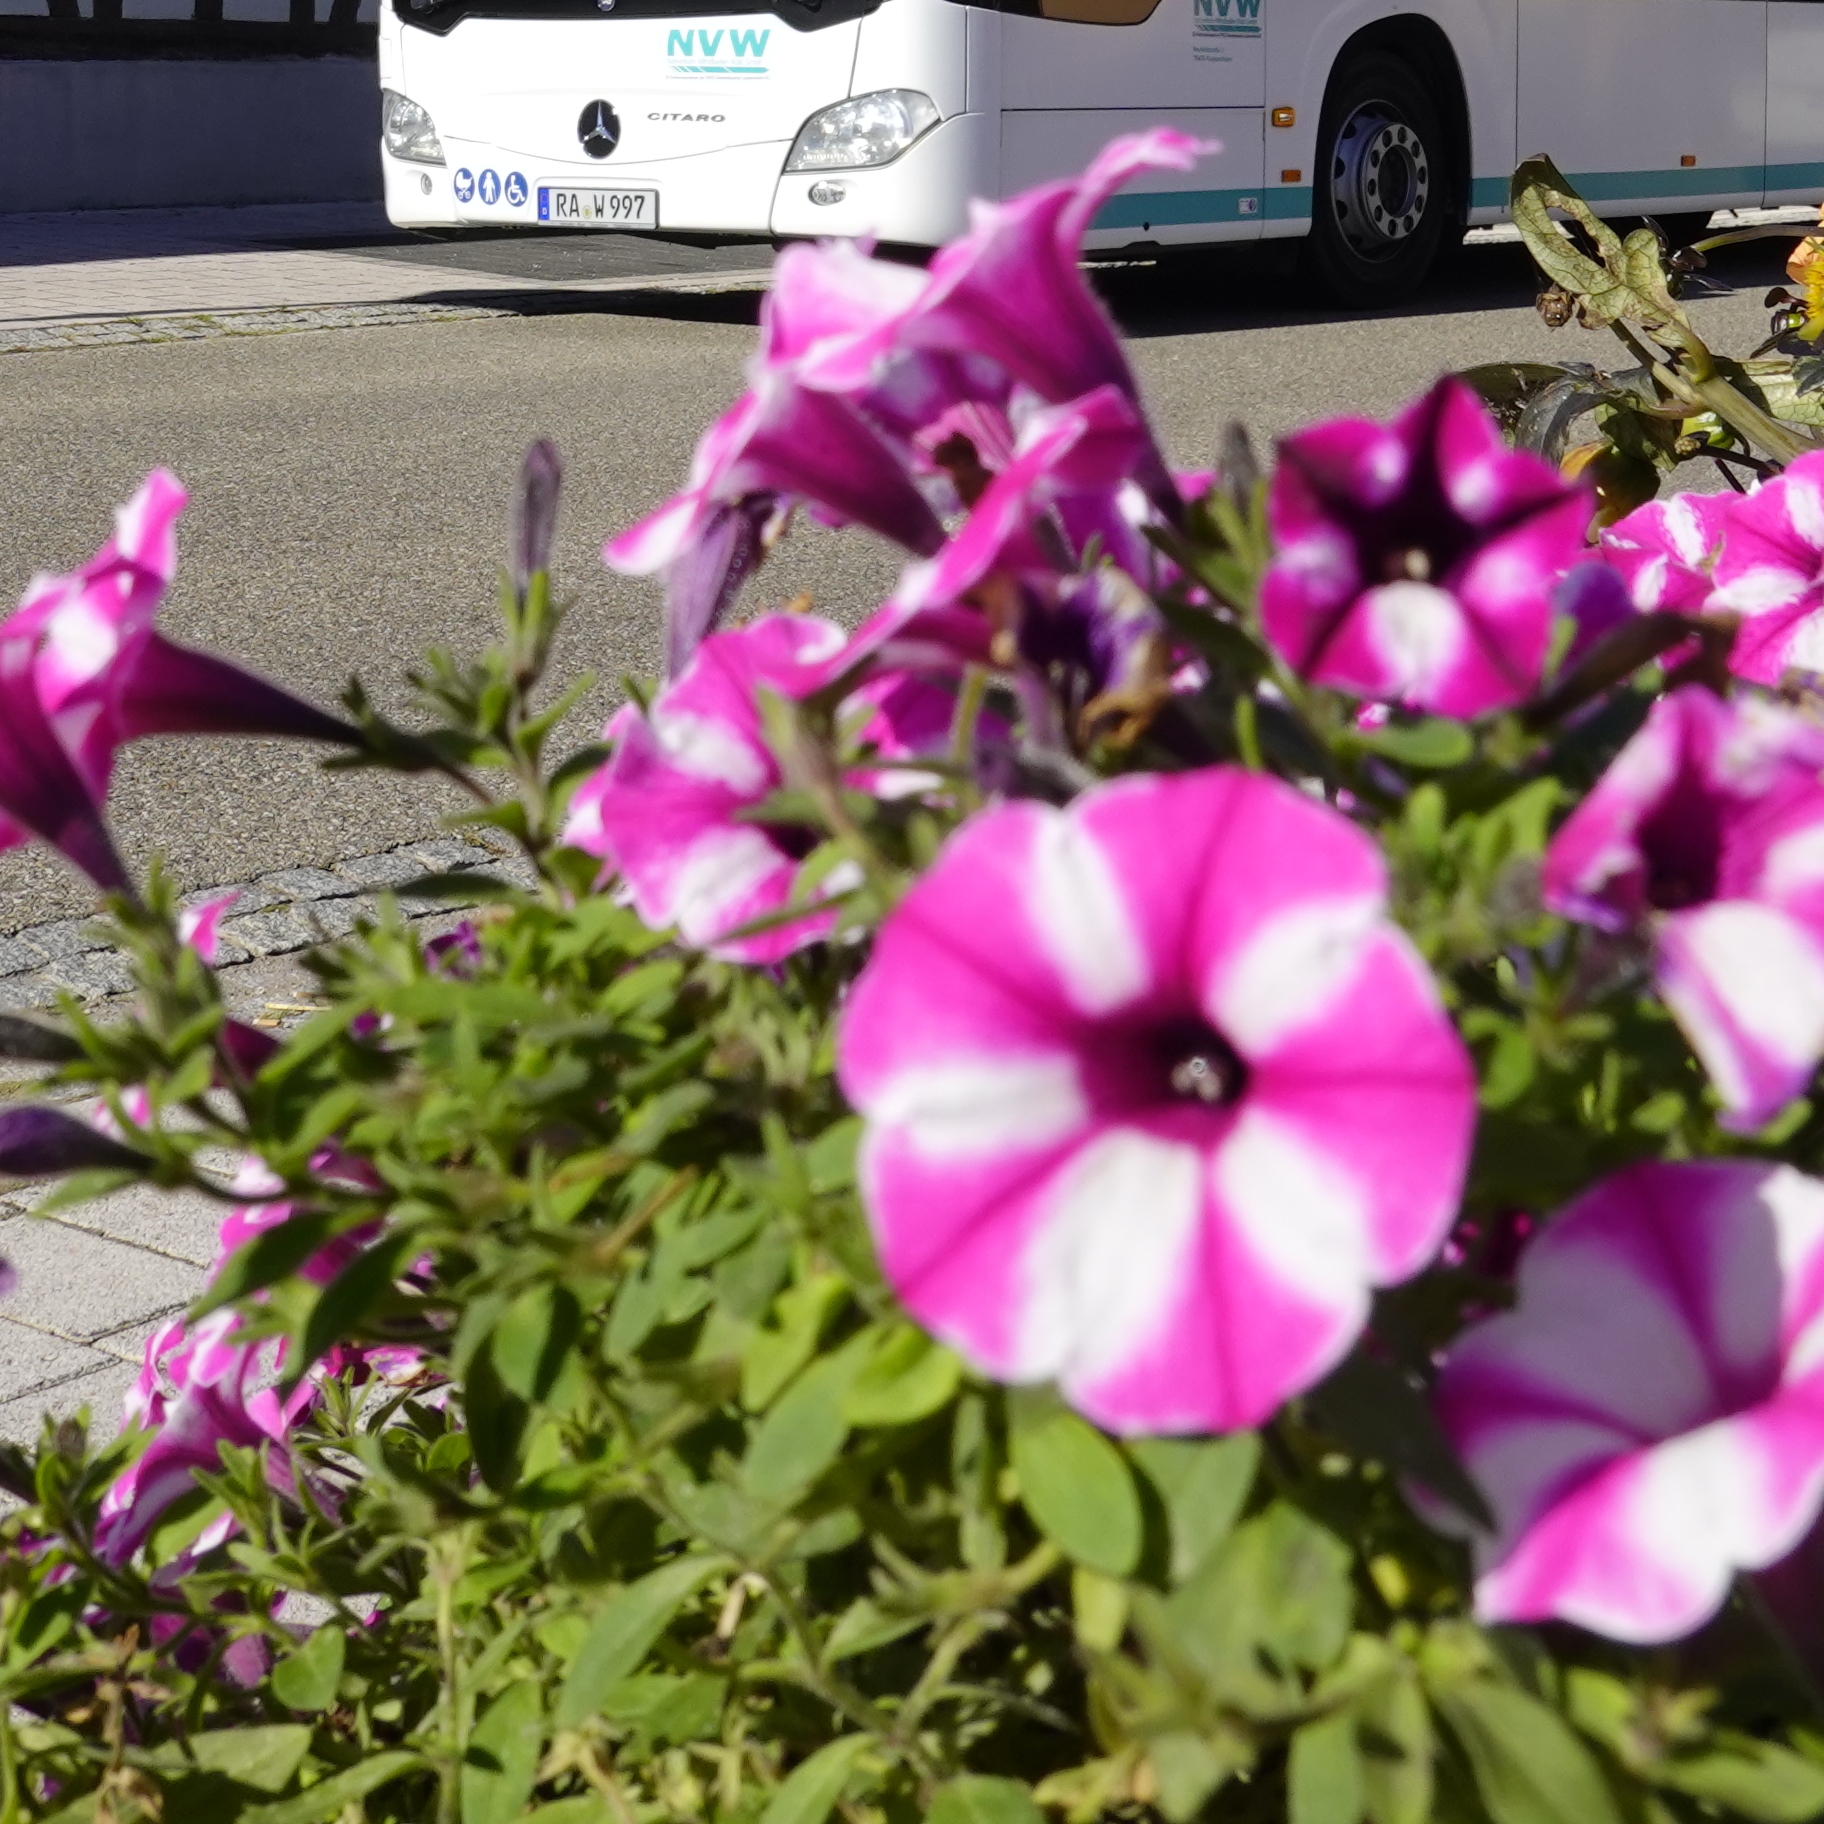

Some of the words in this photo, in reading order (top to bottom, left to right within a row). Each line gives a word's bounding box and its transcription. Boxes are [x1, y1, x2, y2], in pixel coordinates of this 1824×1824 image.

[667, 29, 771, 57] NVW
[647, 112, 726, 123] CITARO
[556, 193, 580, 218] RA
[593, 193, 605, 218] W
[609, 194, 645, 219] 997
